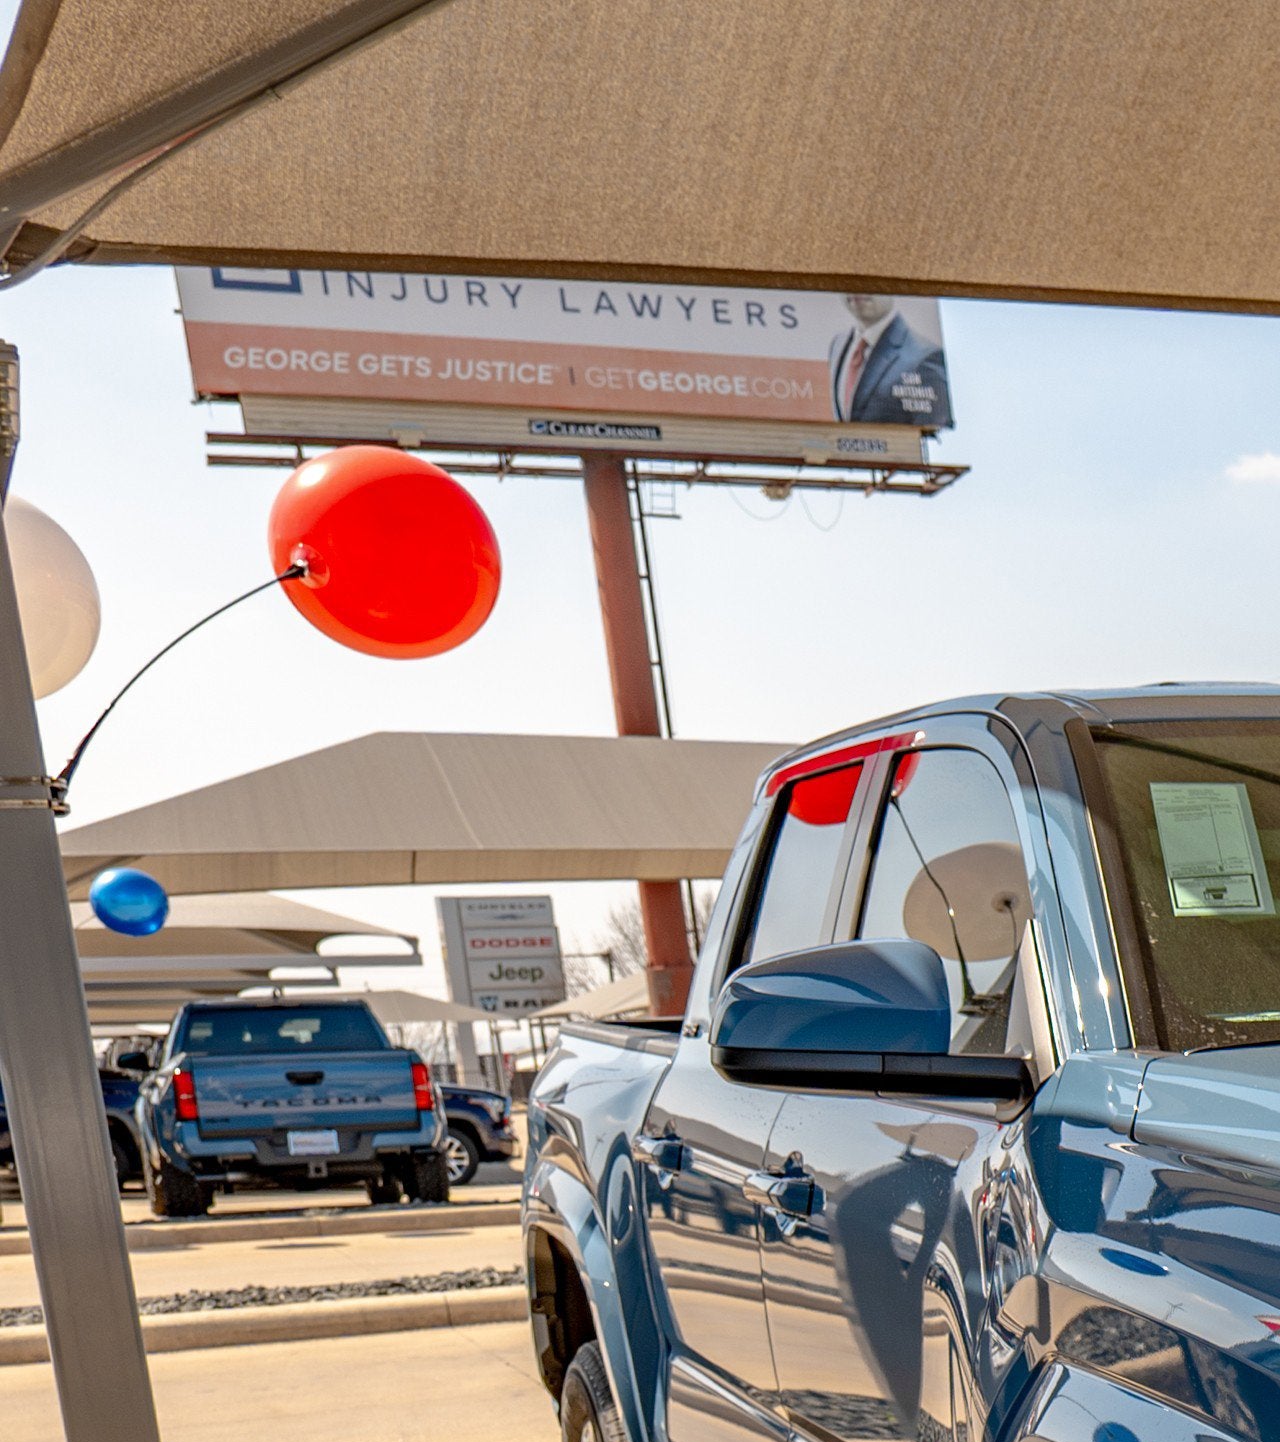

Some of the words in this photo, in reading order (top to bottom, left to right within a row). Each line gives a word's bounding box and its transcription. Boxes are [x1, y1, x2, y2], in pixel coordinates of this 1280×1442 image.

[320, 270, 523, 309] INJURY
[559, 287, 799, 329] LAWYERS
[223, 346, 349, 374] GEORGE
[357, 353, 431, 378] GETS
[584, 366, 813, 400] GETGEORGE.COM
[470, 937, 553, 949] DODGE
[489, 961, 544, 983] Jeep
